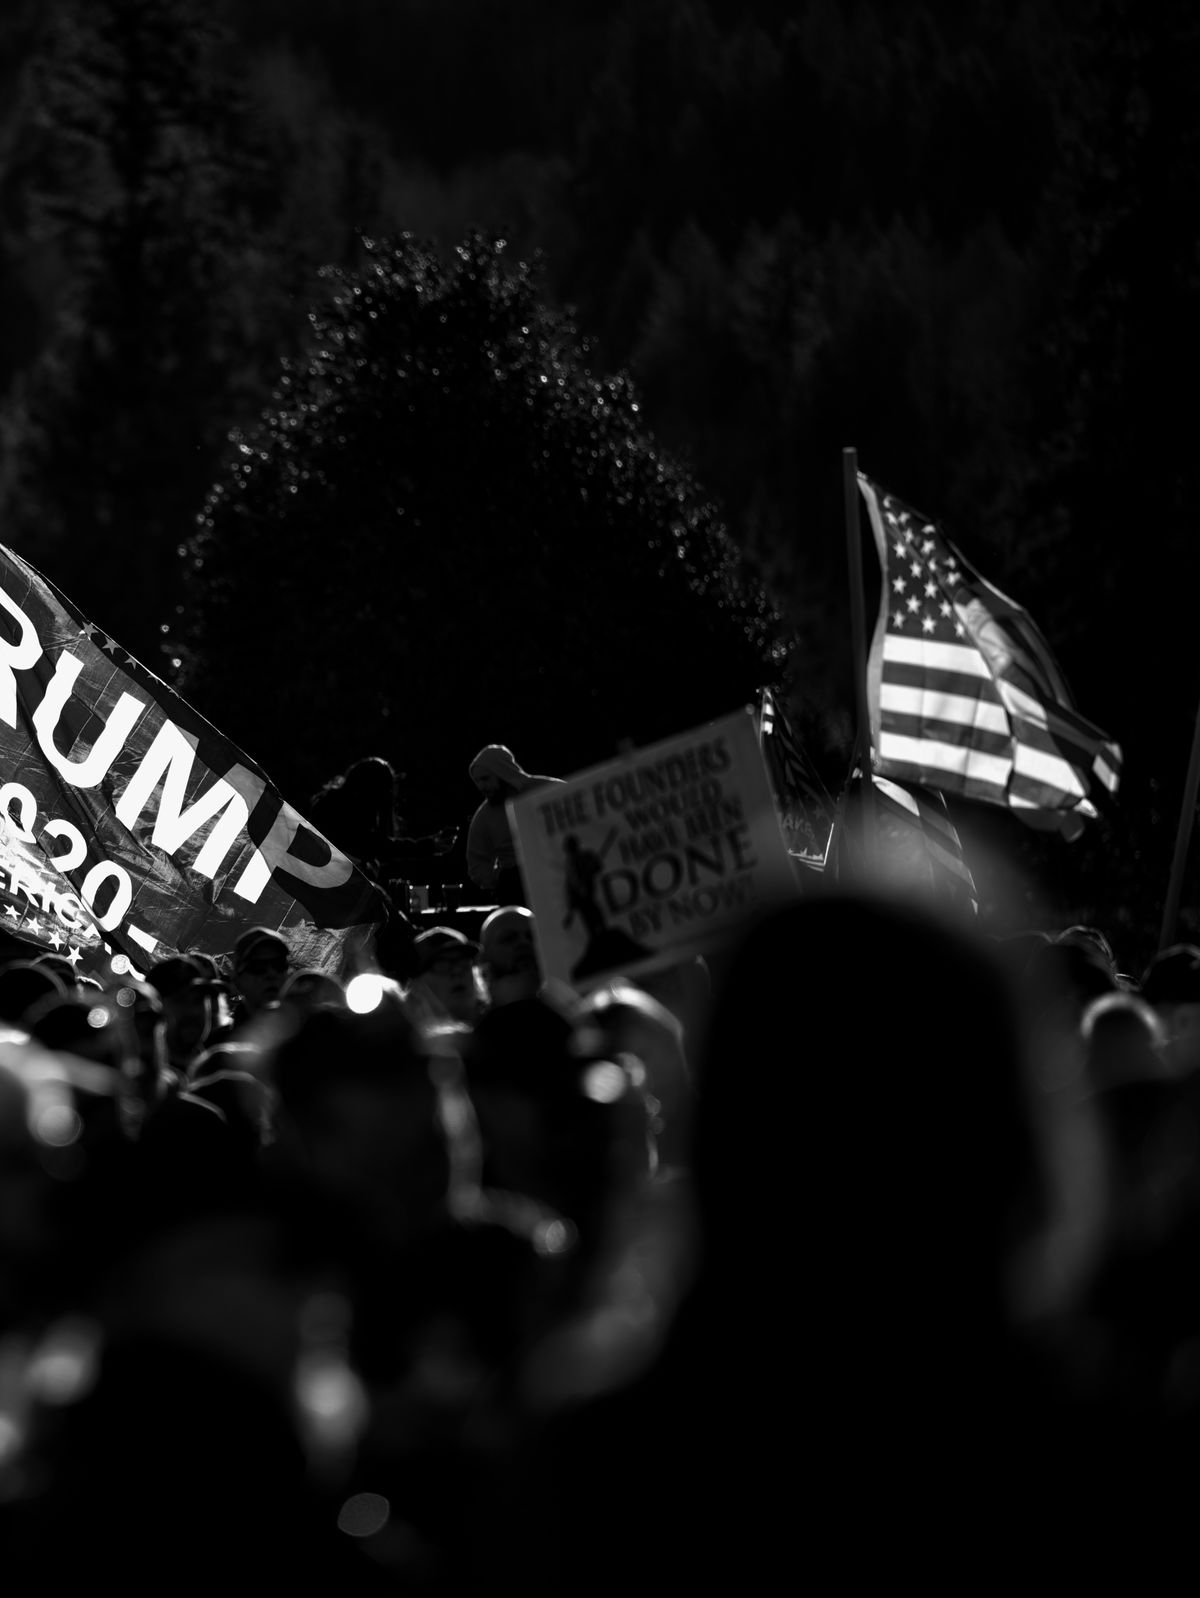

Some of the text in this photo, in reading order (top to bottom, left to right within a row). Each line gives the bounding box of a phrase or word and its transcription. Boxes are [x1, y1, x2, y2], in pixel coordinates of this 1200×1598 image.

[538, 737, 732, 837] THE FOUNDERS
[623, 777, 723, 831] WOULD
[600, 823, 758, 917] DONE
[628, 902, 662, 939] BY
